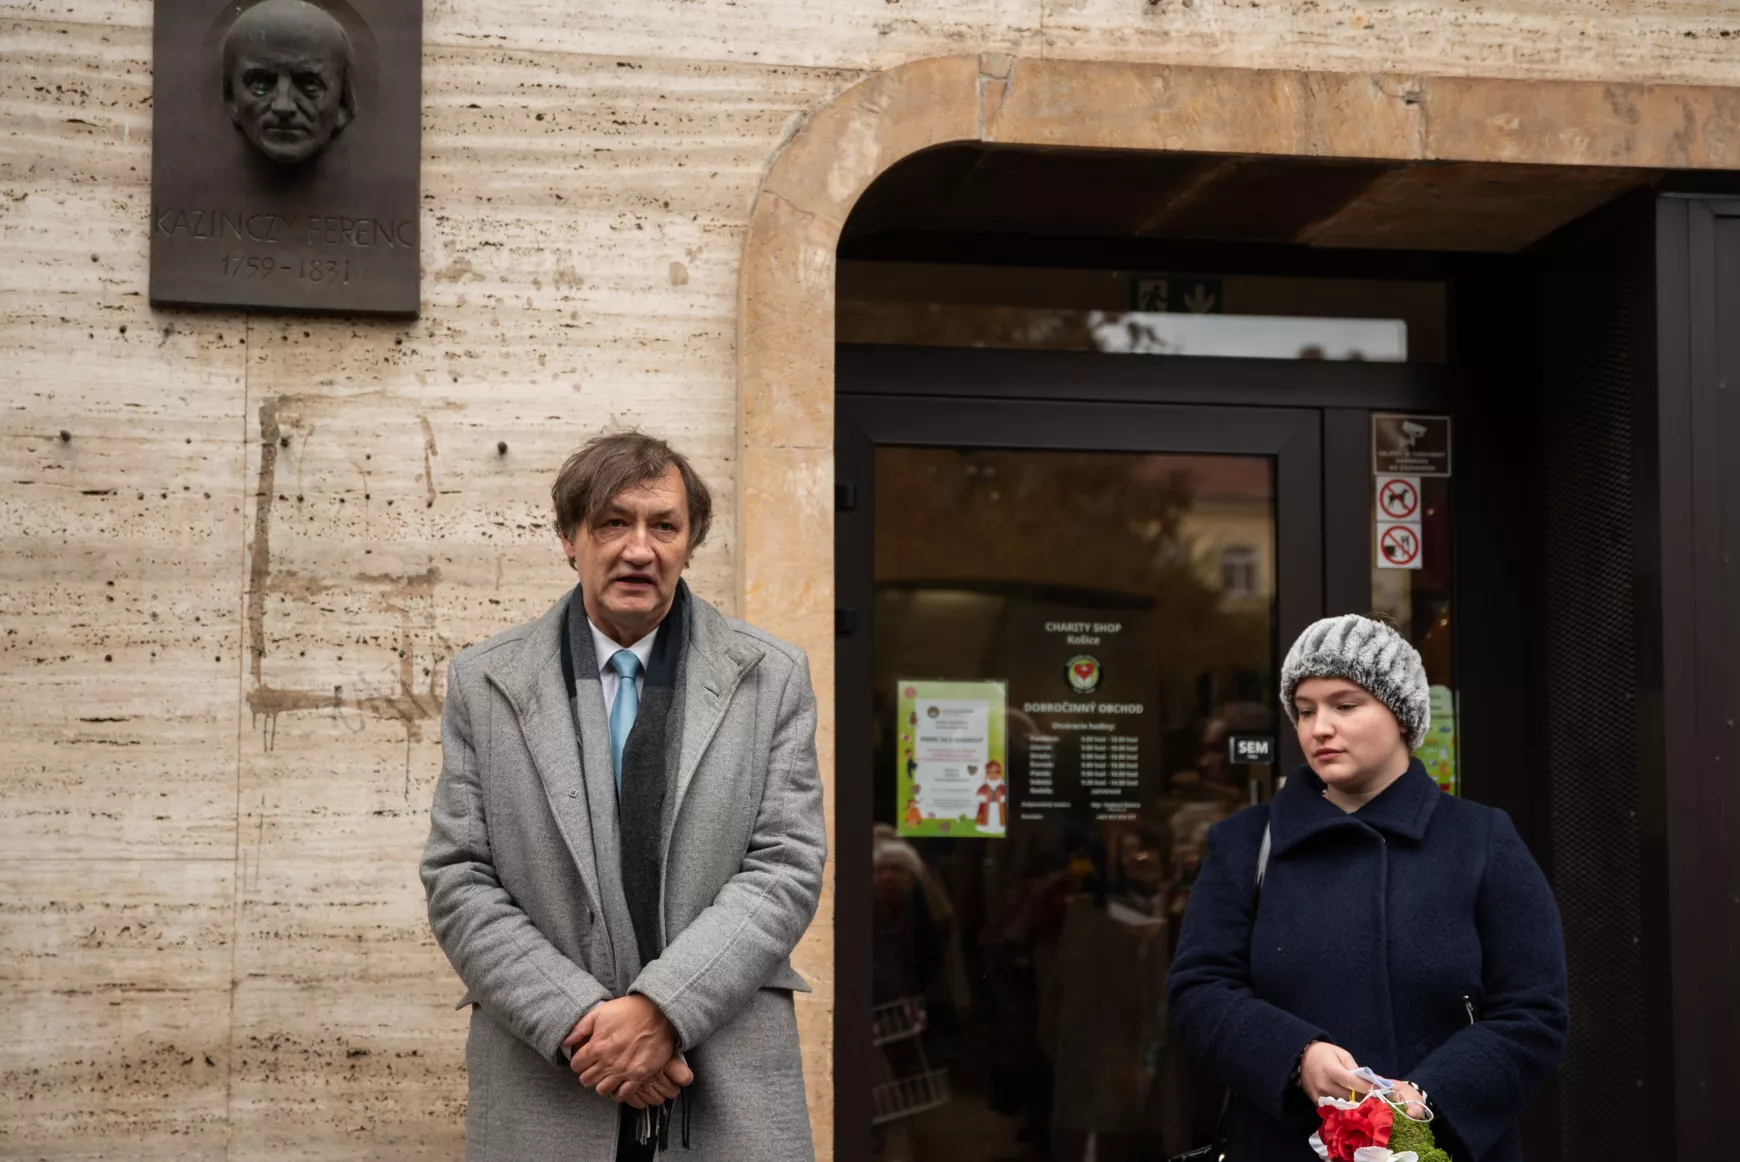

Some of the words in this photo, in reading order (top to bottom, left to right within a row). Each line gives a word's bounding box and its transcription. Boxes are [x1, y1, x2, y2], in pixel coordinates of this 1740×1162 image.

[154, 206, 299, 243] KAZINCZY
[307, 214, 415, 247] FERENC
[1045, 621, 1092, 632] CHARITY
[1093, 622, 1122, 633] SHOP
[1067, 634, 1101, 645] Košice
[1023, 701, 1096, 713] DOBROČINNÝ
[1098, 703, 1144, 714] OBCHOD
[1238, 740, 1268, 754] SEM
